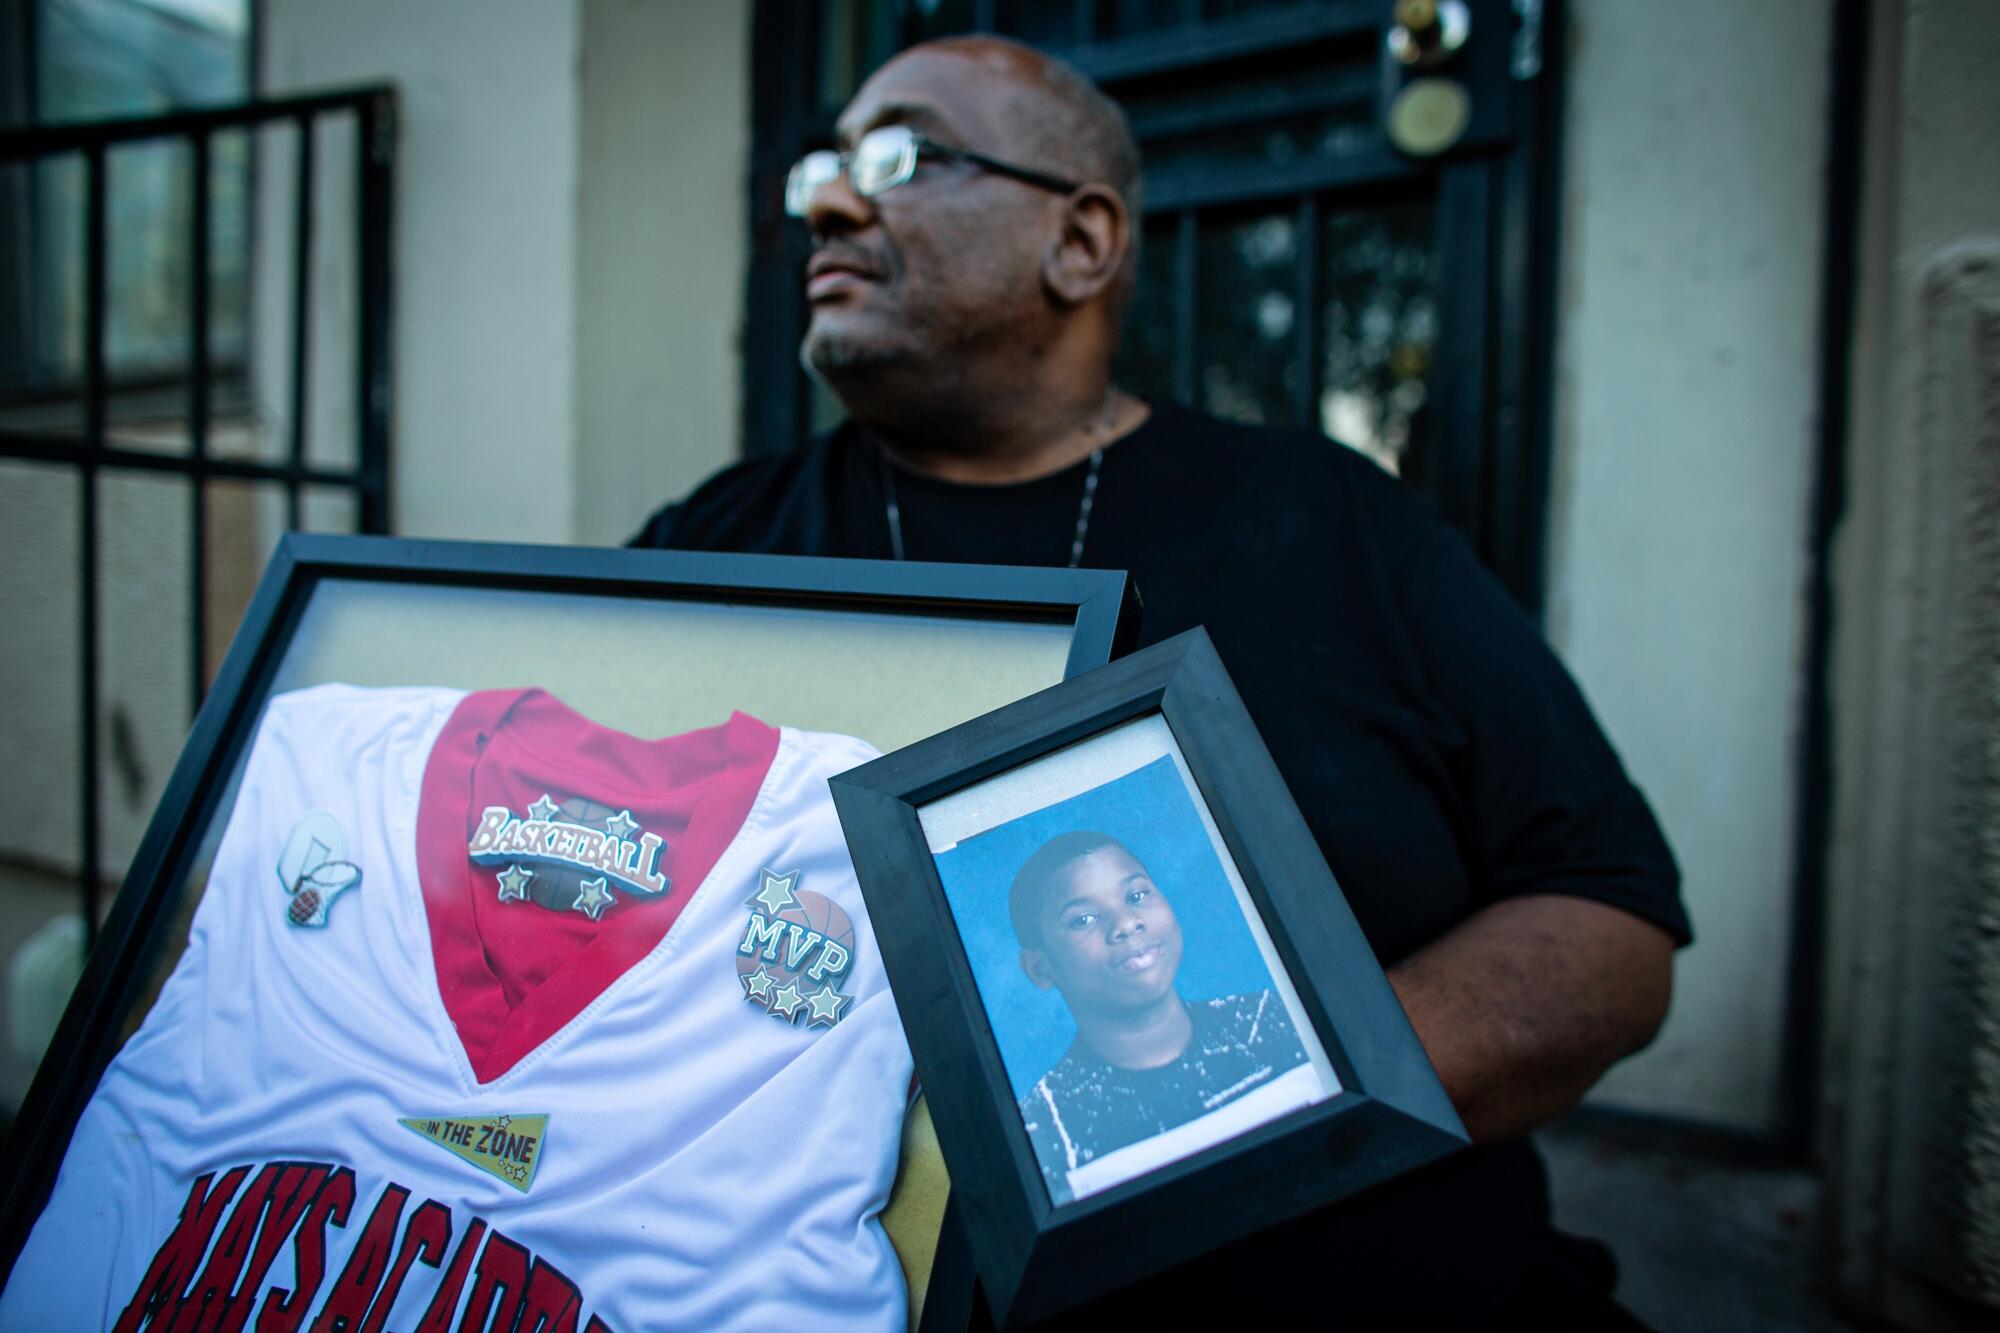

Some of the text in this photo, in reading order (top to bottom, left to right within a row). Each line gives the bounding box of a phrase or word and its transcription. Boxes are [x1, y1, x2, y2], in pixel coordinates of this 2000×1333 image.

[469, 806, 667, 894] BASKETBALL
[739, 914, 851, 981] MVP
[427, 1120, 536, 1164] IN THE ZONE
[111, 1160, 356, 1333] MAYS
